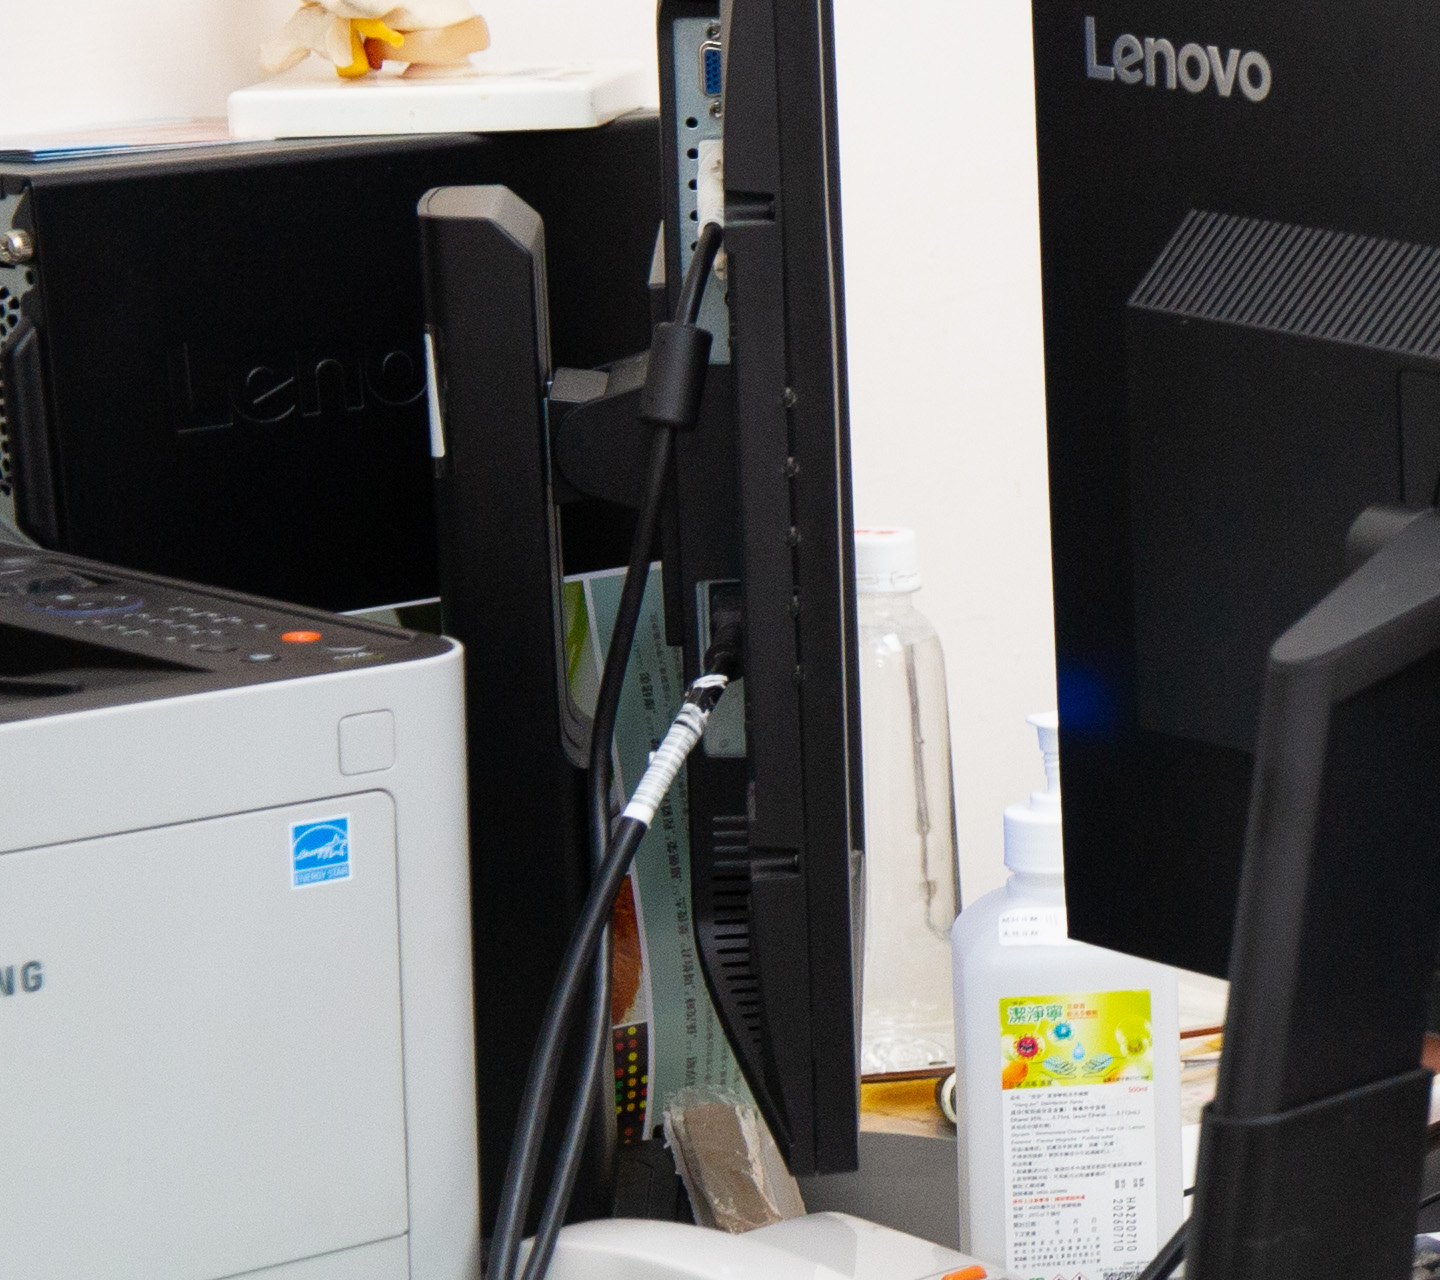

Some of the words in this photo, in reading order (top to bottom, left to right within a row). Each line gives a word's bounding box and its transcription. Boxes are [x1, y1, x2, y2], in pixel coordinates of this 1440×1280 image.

[1085, 16, 1272, 102] Lenovo
[168, 342, 428, 435] Leno
[1113, 1198, 1125, 1252] 20260710
[1126, 1196, 1138, 1252] HA220710
